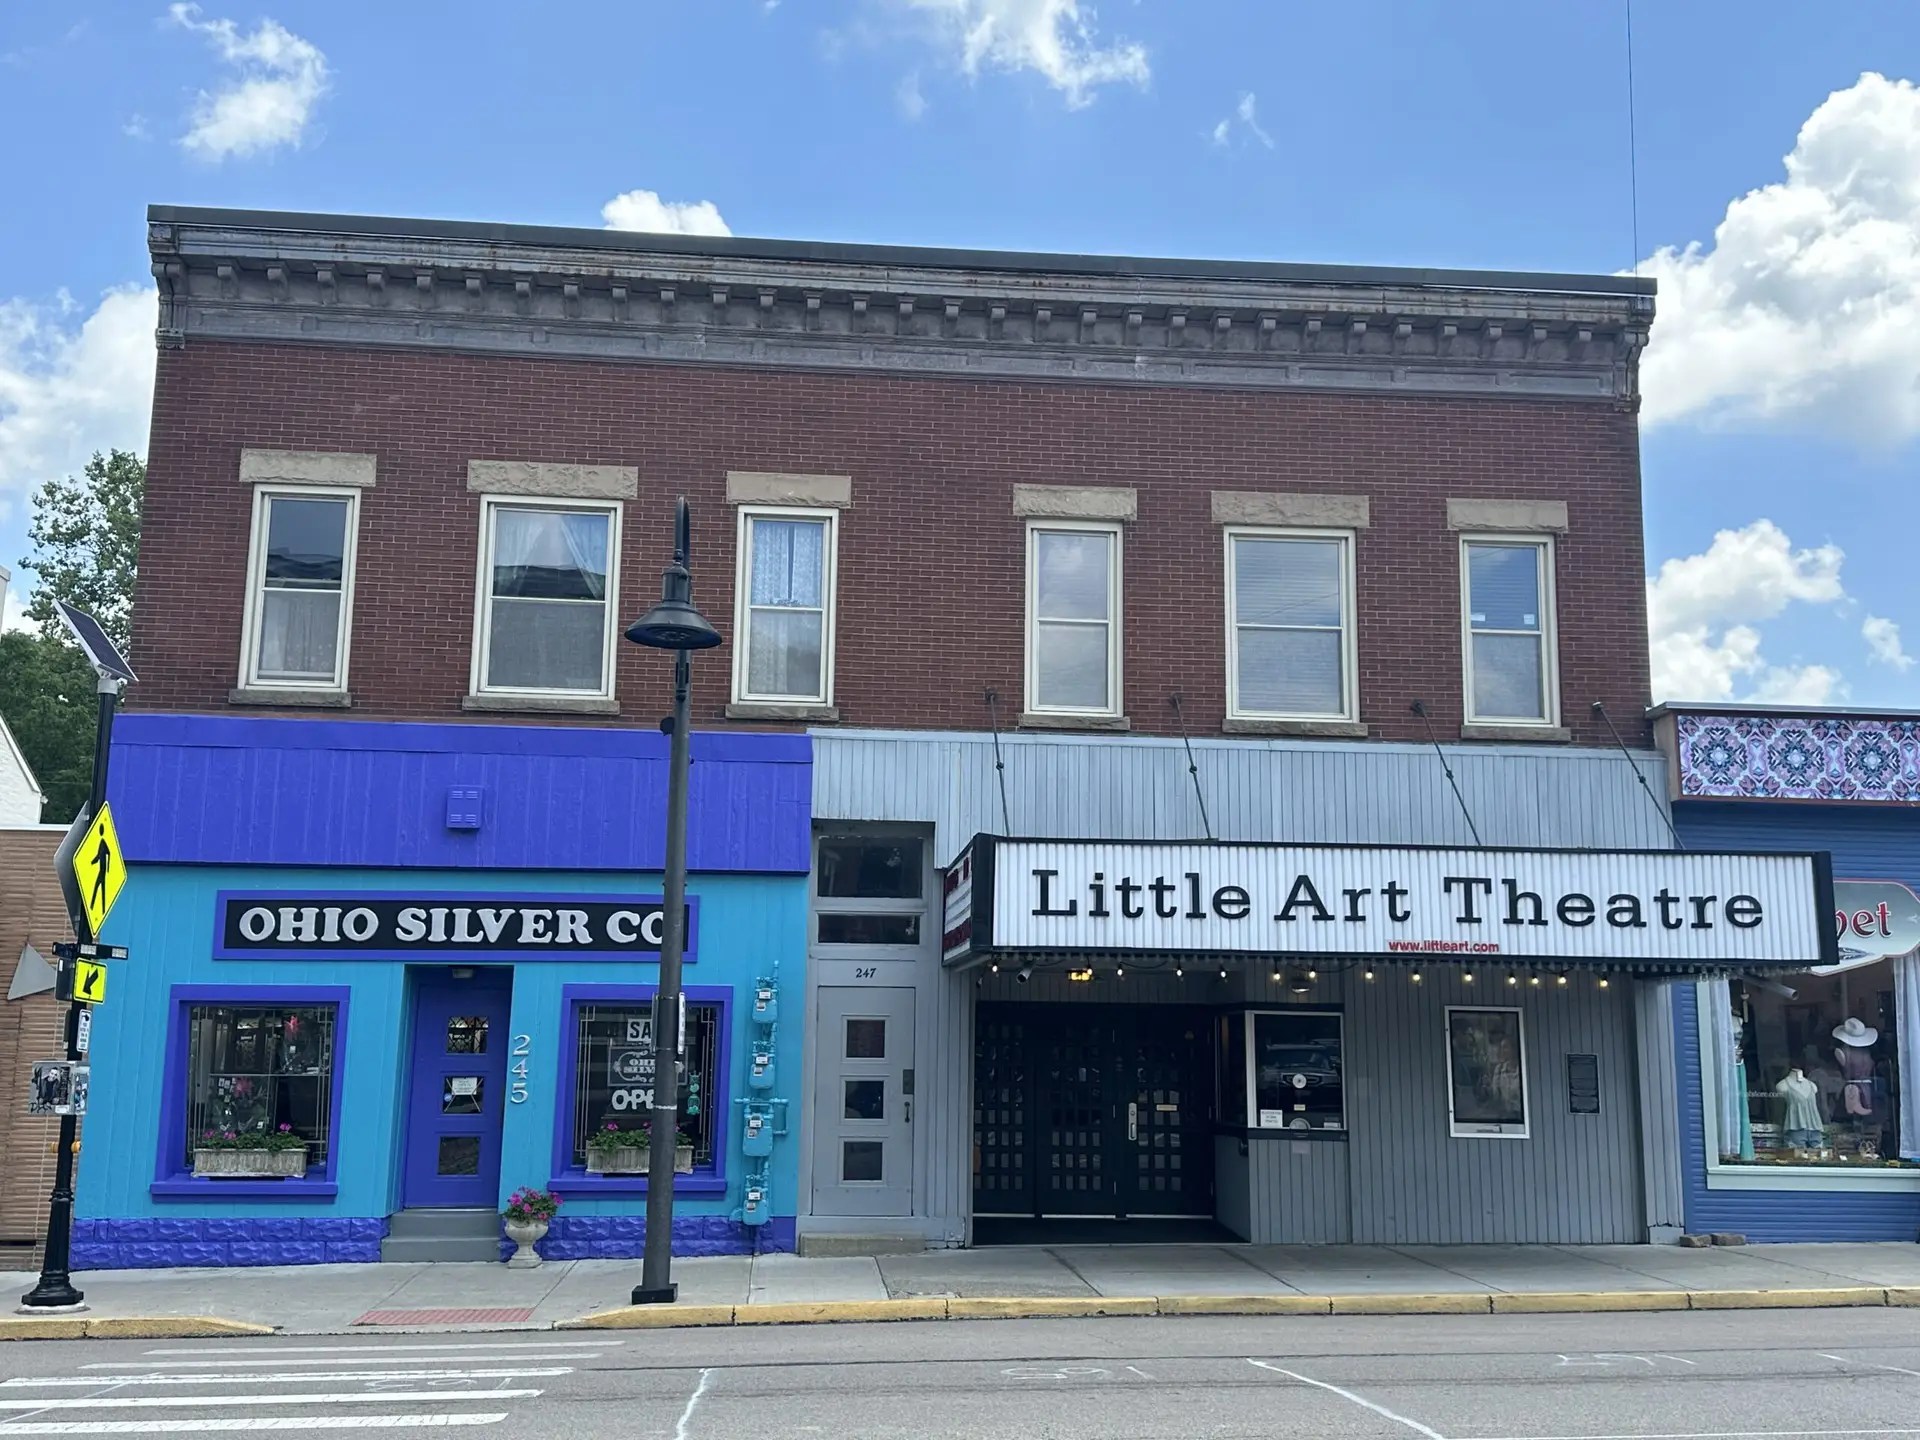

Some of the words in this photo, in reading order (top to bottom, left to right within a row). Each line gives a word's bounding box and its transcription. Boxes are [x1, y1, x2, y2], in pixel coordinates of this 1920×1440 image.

[1032, 869, 1250, 919] Little
[1274, 874, 1411, 922] Art
[1443, 877, 1763, 929] Theatre
[239, 907, 379, 942] OHIO
[395, 907, 593, 944] SILVER
[1388, 940, 1500, 953] www.littleart.com
[855, 967, 877, 979] 247
[629, 1021, 652, 1039] SA
[510, 1034, 531, 1104] 245
